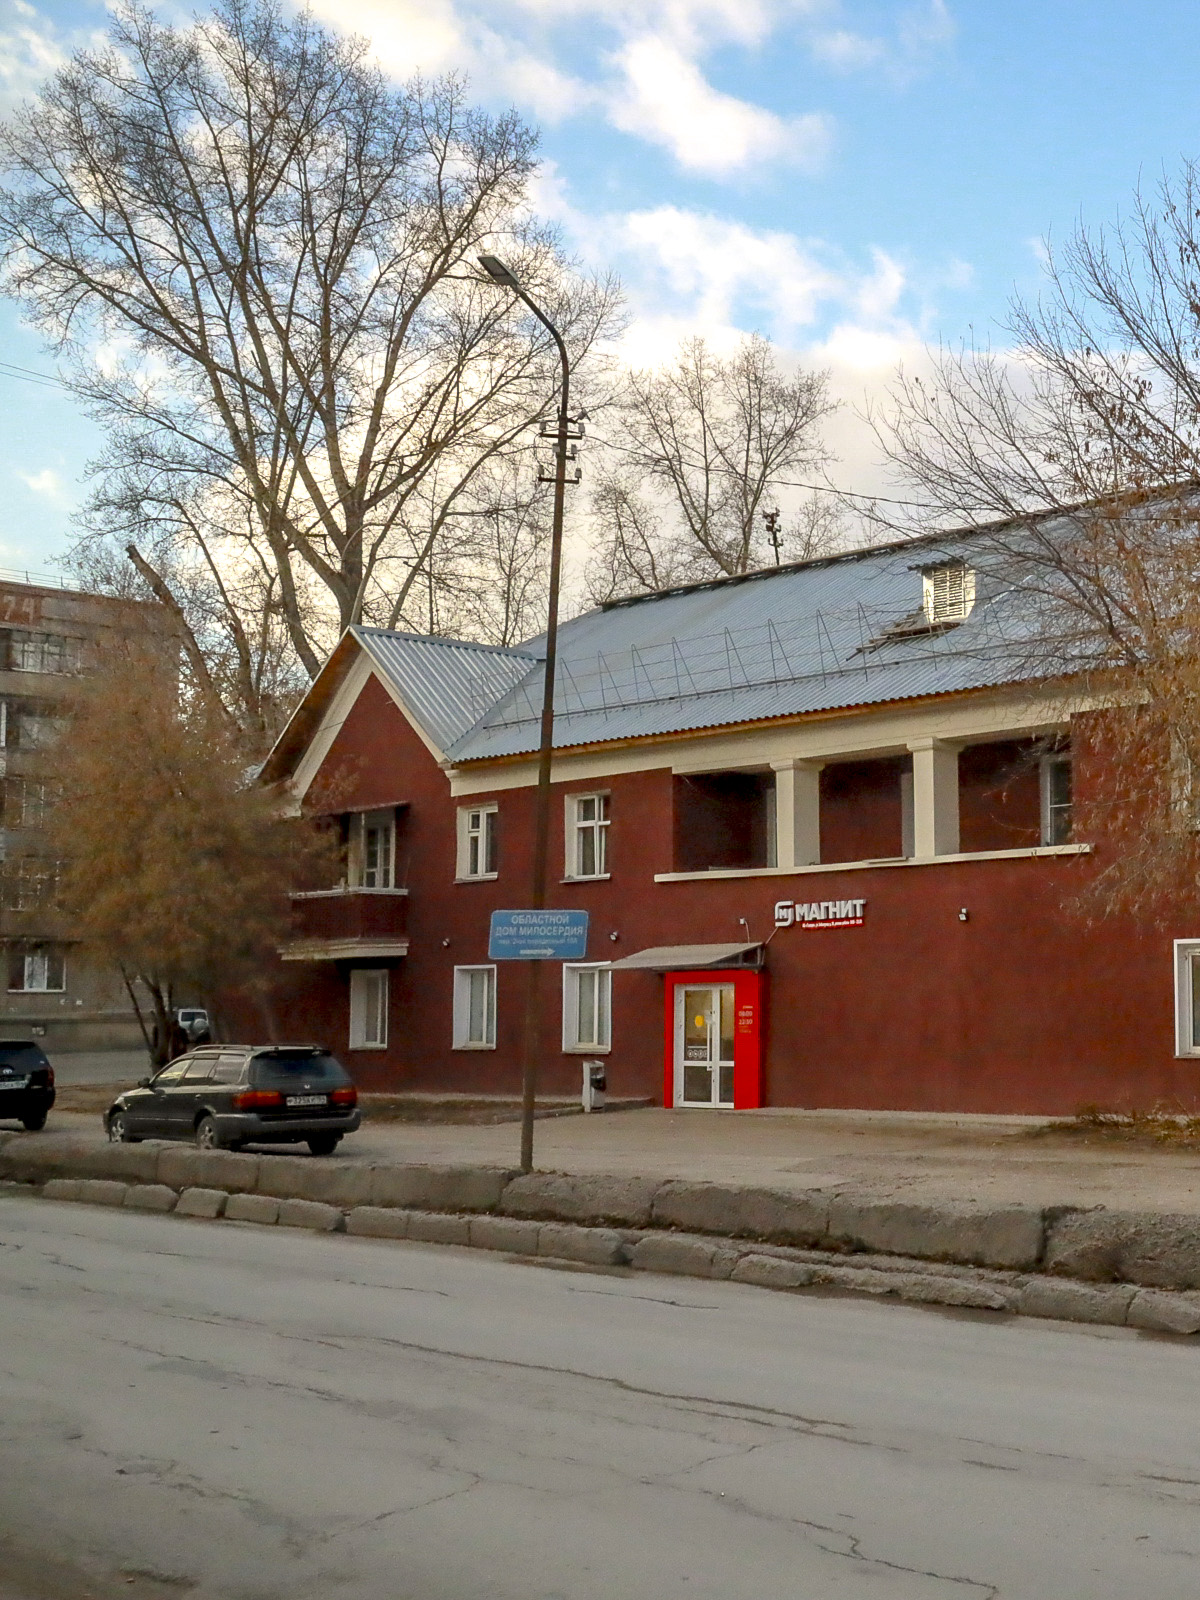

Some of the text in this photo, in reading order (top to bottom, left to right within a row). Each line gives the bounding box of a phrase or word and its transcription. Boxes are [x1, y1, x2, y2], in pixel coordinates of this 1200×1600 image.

[795, 899, 866, 921] МАГНИТ
[511, 914, 570, 924] ОБЛАСТНОЙ
[495, 926, 584, 936] ДОМ МИЛОСЕРДИЯ
